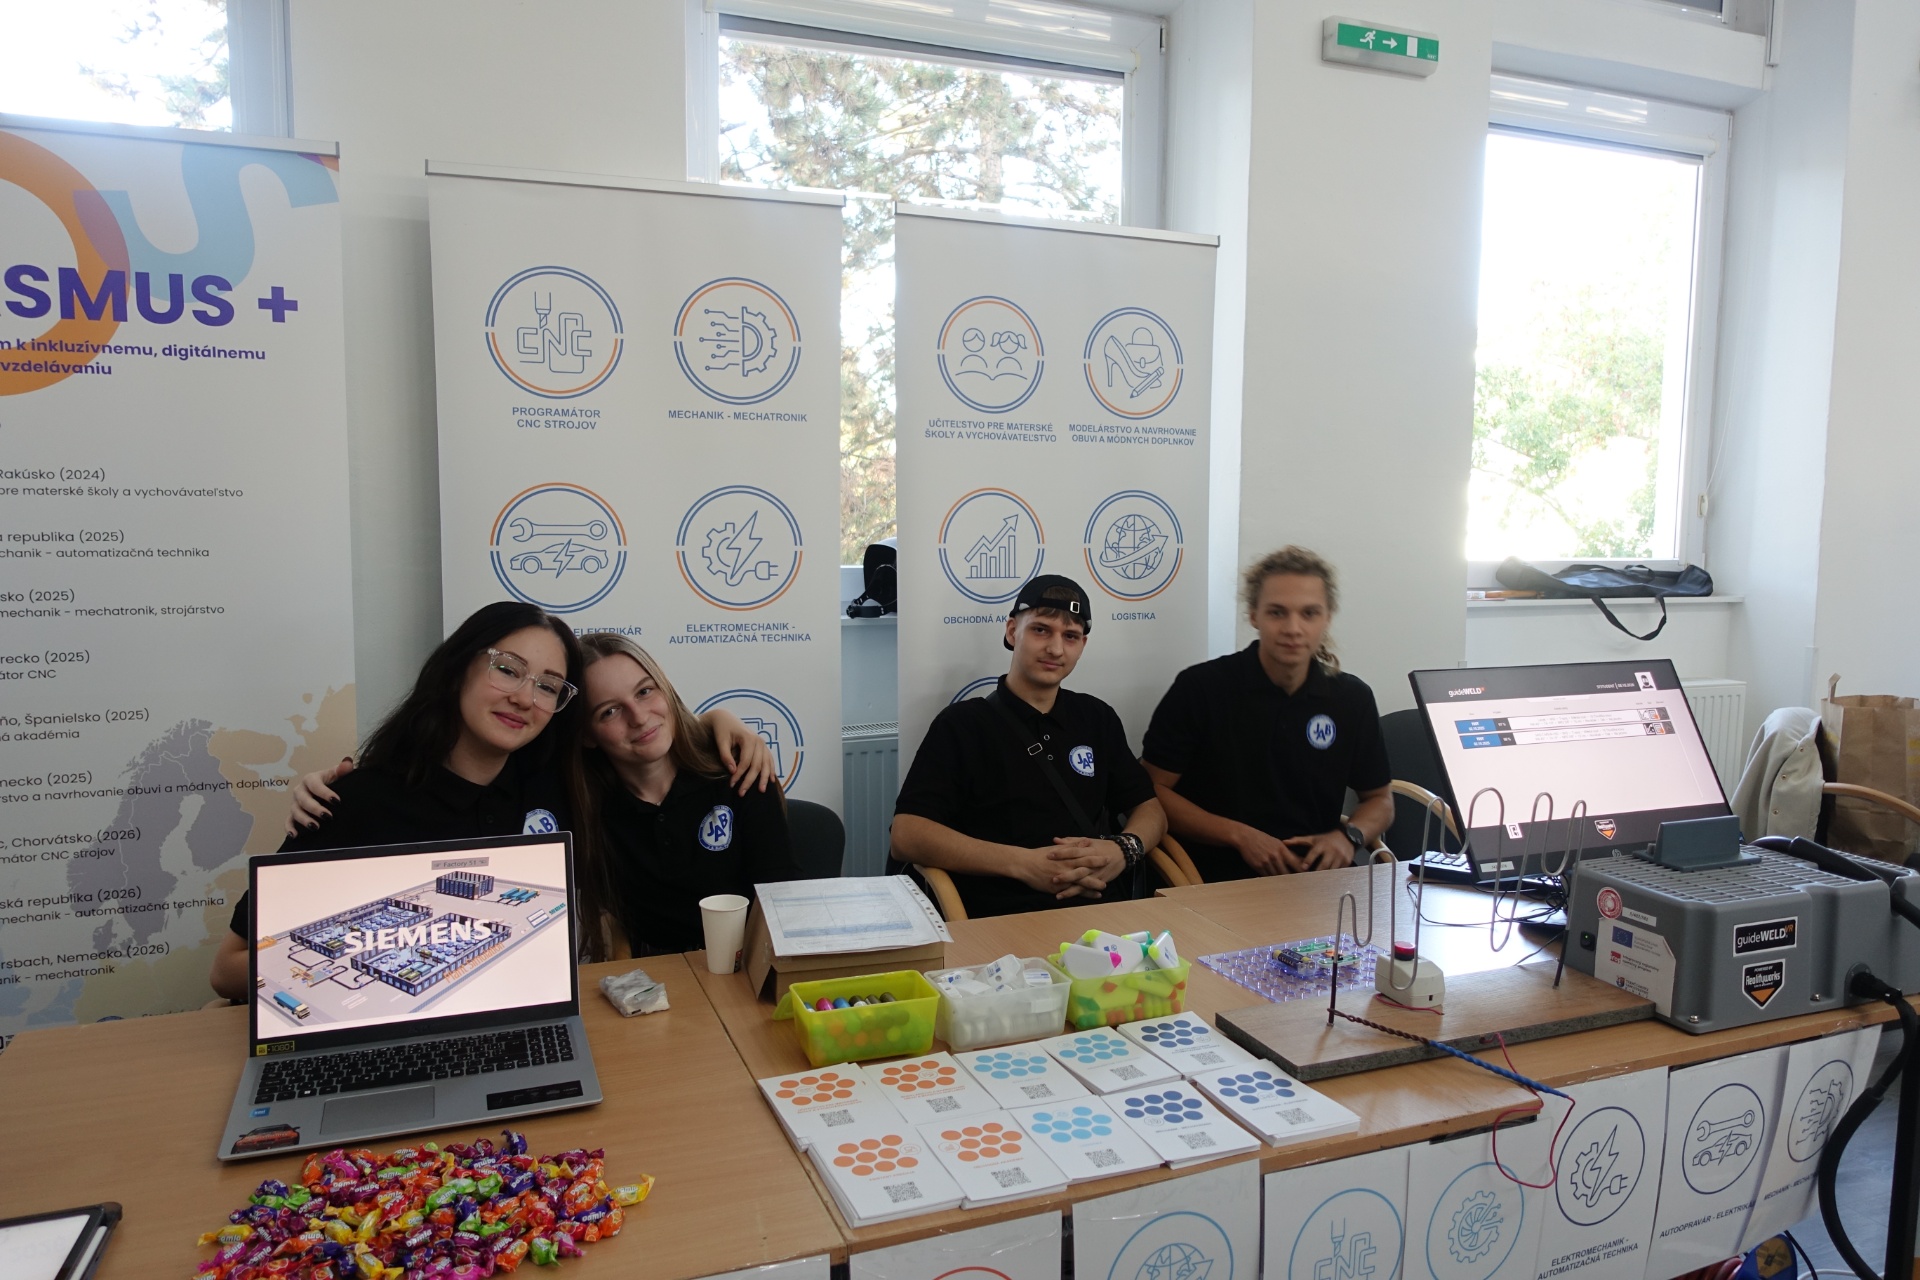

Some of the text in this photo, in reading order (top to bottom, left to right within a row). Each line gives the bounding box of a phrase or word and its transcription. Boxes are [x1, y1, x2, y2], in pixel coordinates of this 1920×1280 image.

[0, 264, 235, 327] SMUS
[16, 338, 26, 351] k
[31, 338, 158, 358] inkluzívnemu,
[162, 344, 266, 361] digitálnemu
[1, 360, 112, 375] vzdelávaniu
[511, 405, 601, 419] PROGRAMÁTOR
[668, 409, 725, 420] MECHANIK
[733, 411, 808, 422] MECHATRONIK
[516, 418, 597, 430] CNC STROJOV
[928, 418, 1053, 432] UČITEĽSTVO PRE MATERSKÉ
[1068, 423, 1197, 437] MODELÁRSTVO A NAVRHOVANIE
[924, 428, 1057, 443] ŠKOLY A VYCHOVÁVATEĽSTVO
[1071, 433, 1195, 446] OBUVI A MÓDNYCH DOPLNKOV
[59, 467, 106, 481] (2024)
[22, 485, 84, 496] materské
[87, 484, 119, 499] školy
[122, 488, 131, 497] a
[134, 486, 243, 499] vychovávateľstvo
[7, 530, 75, 545] republika
[78, 529, 125, 543] (2025)
[55, 547, 154, 558] automatizačná
[157, 547, 210, 558] technika
[28, 588, 75, 603] (2025)
[0, 606, 61, 618] mechanik
[74, 605, 158, 617] mechatronik,
[160, 604, 225, 617] strojárstvo
[1111, 612, 1156, 621] LOGISTIKA
[943, 613, 994, 625] OBCHODNÁ
[686, 622, 789, 633] ELEKTROMECHANIK
[668, 633, 812, 644] AUTOMATIZAČNÁ TECHNIKA
[44, 650, 90, 664] (2025)
[27, 669, 57, 680] CNC
[24, 711, 101, 728] Španielsko
[105, 708, 150, 723] (2025)
[14, 729, 80, 742] akadémia
[1313, 722, 1331, 741] JAB
[1077, 752, 1094, 769] JAB
[47, 771, 93, 787] (2025)
[0, 777, 290, 803] stvo a navrhovanie obuvi a módnych doplnkov
[707, 813, 728, 842] JAB
[11, 831, 93, 848] Chorvátsko
[96, 827, 141, 844] (2026)
[40, 849, 70, 861] CNC
[73, 846, 115, 860] strojov
[443, 859, 467, 869] Factory
[27, 891, 93, 908] republika
[97, 886, 142, 903] (2026)
[0, 909, 61, 924] mechanik
[75, 901, 170, 918] automatizačná
[173, 896, 225, 910] technika
[344, 918, 493, 954] SIEMENS
[1737, 928, 1786, 948] guideWELD
[57, 947, 123, 963] Nemecko
[126, 942, 170, 958] (2026)
[35, 964, 115, 982] mechatronik
[1745, 971, 1781, 986] Realityworks
[1659, 1215, 1712, 1239] AUTOOPRAVÁR
[1551, 1237, 1625, 1267] ELEKTROMECHANIK
[1537, 1243, 1639, 1280] AUTOMATIZAČNÁ TECHNIKA
